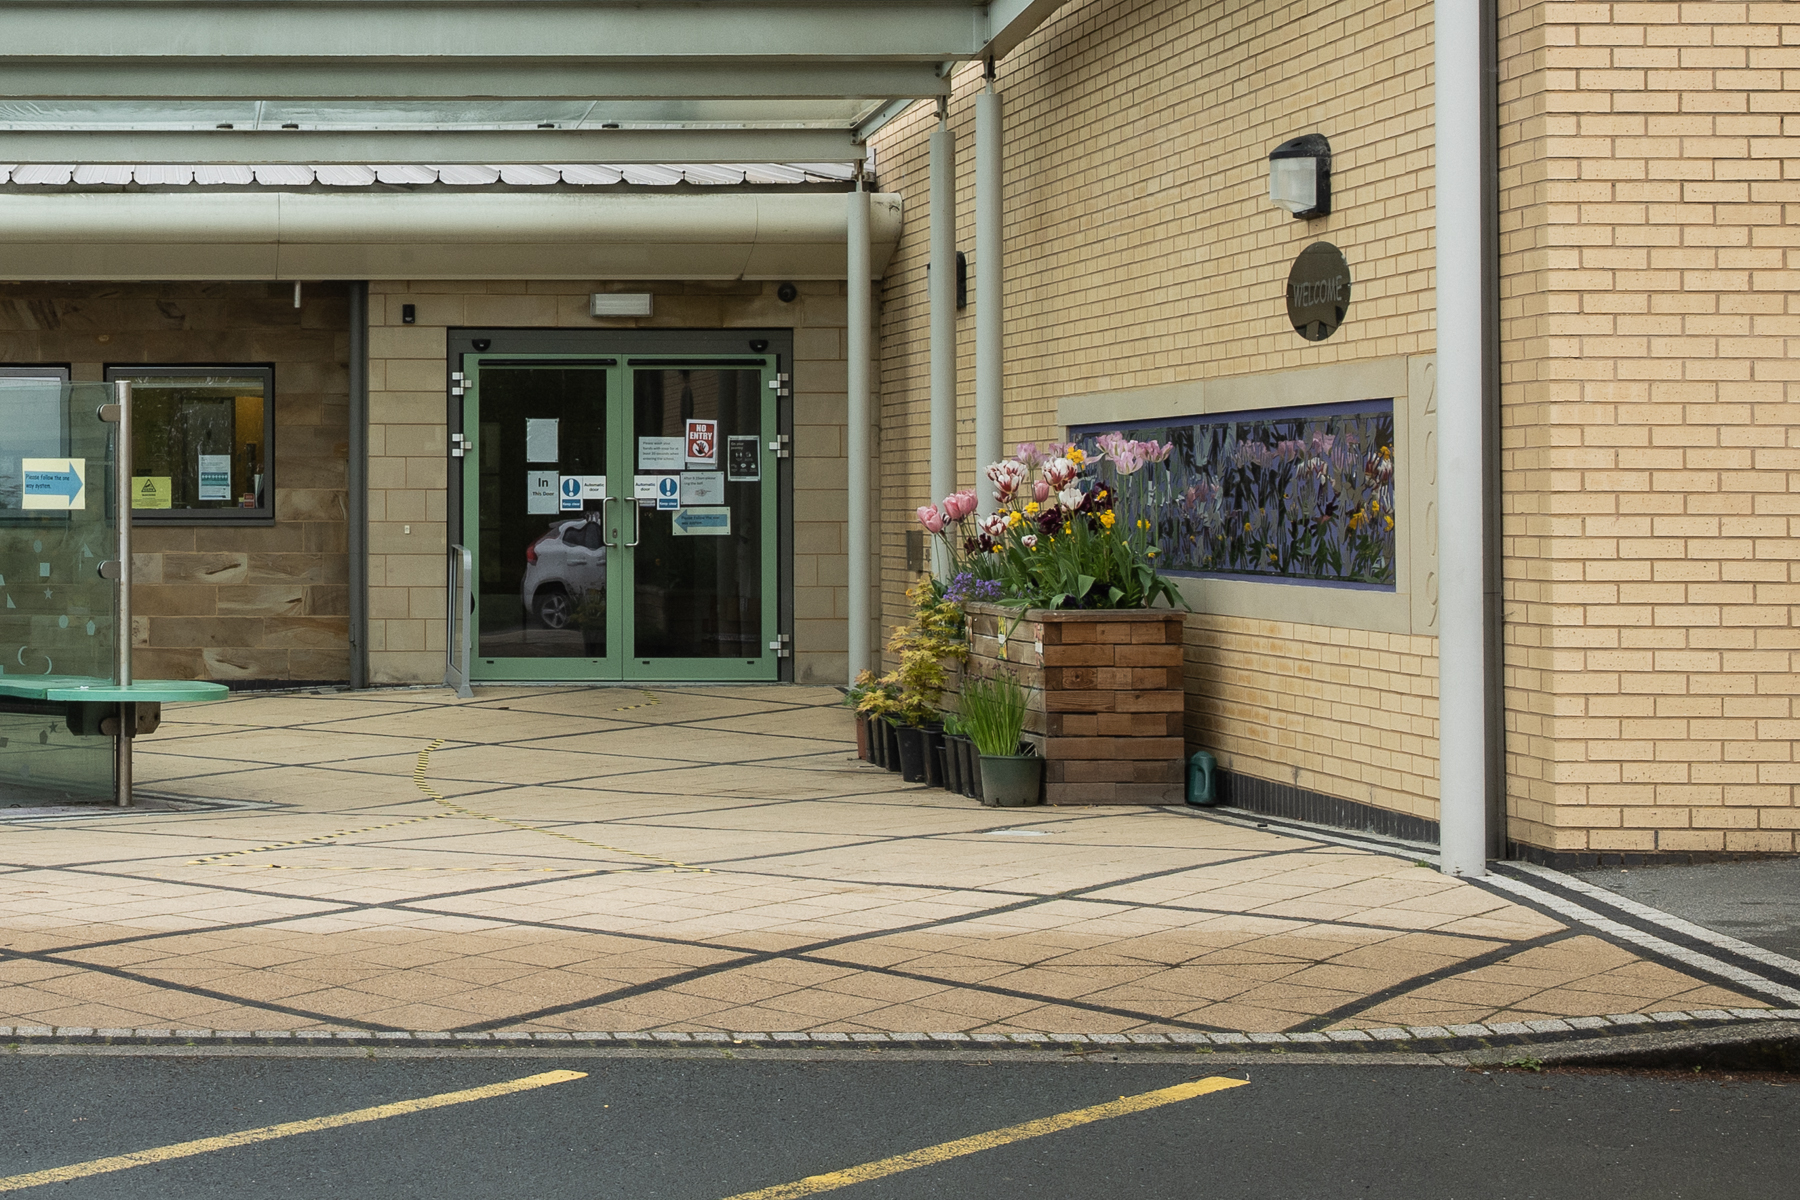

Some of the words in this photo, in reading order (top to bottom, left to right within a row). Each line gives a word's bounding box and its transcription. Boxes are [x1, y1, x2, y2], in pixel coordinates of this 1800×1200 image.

[1292, 274, 1343, 308] WELCOME
[696, 424, 707, 432] NO
[690, 432, 712, 440] ENTRY
[538, 477, 548, 487] In
